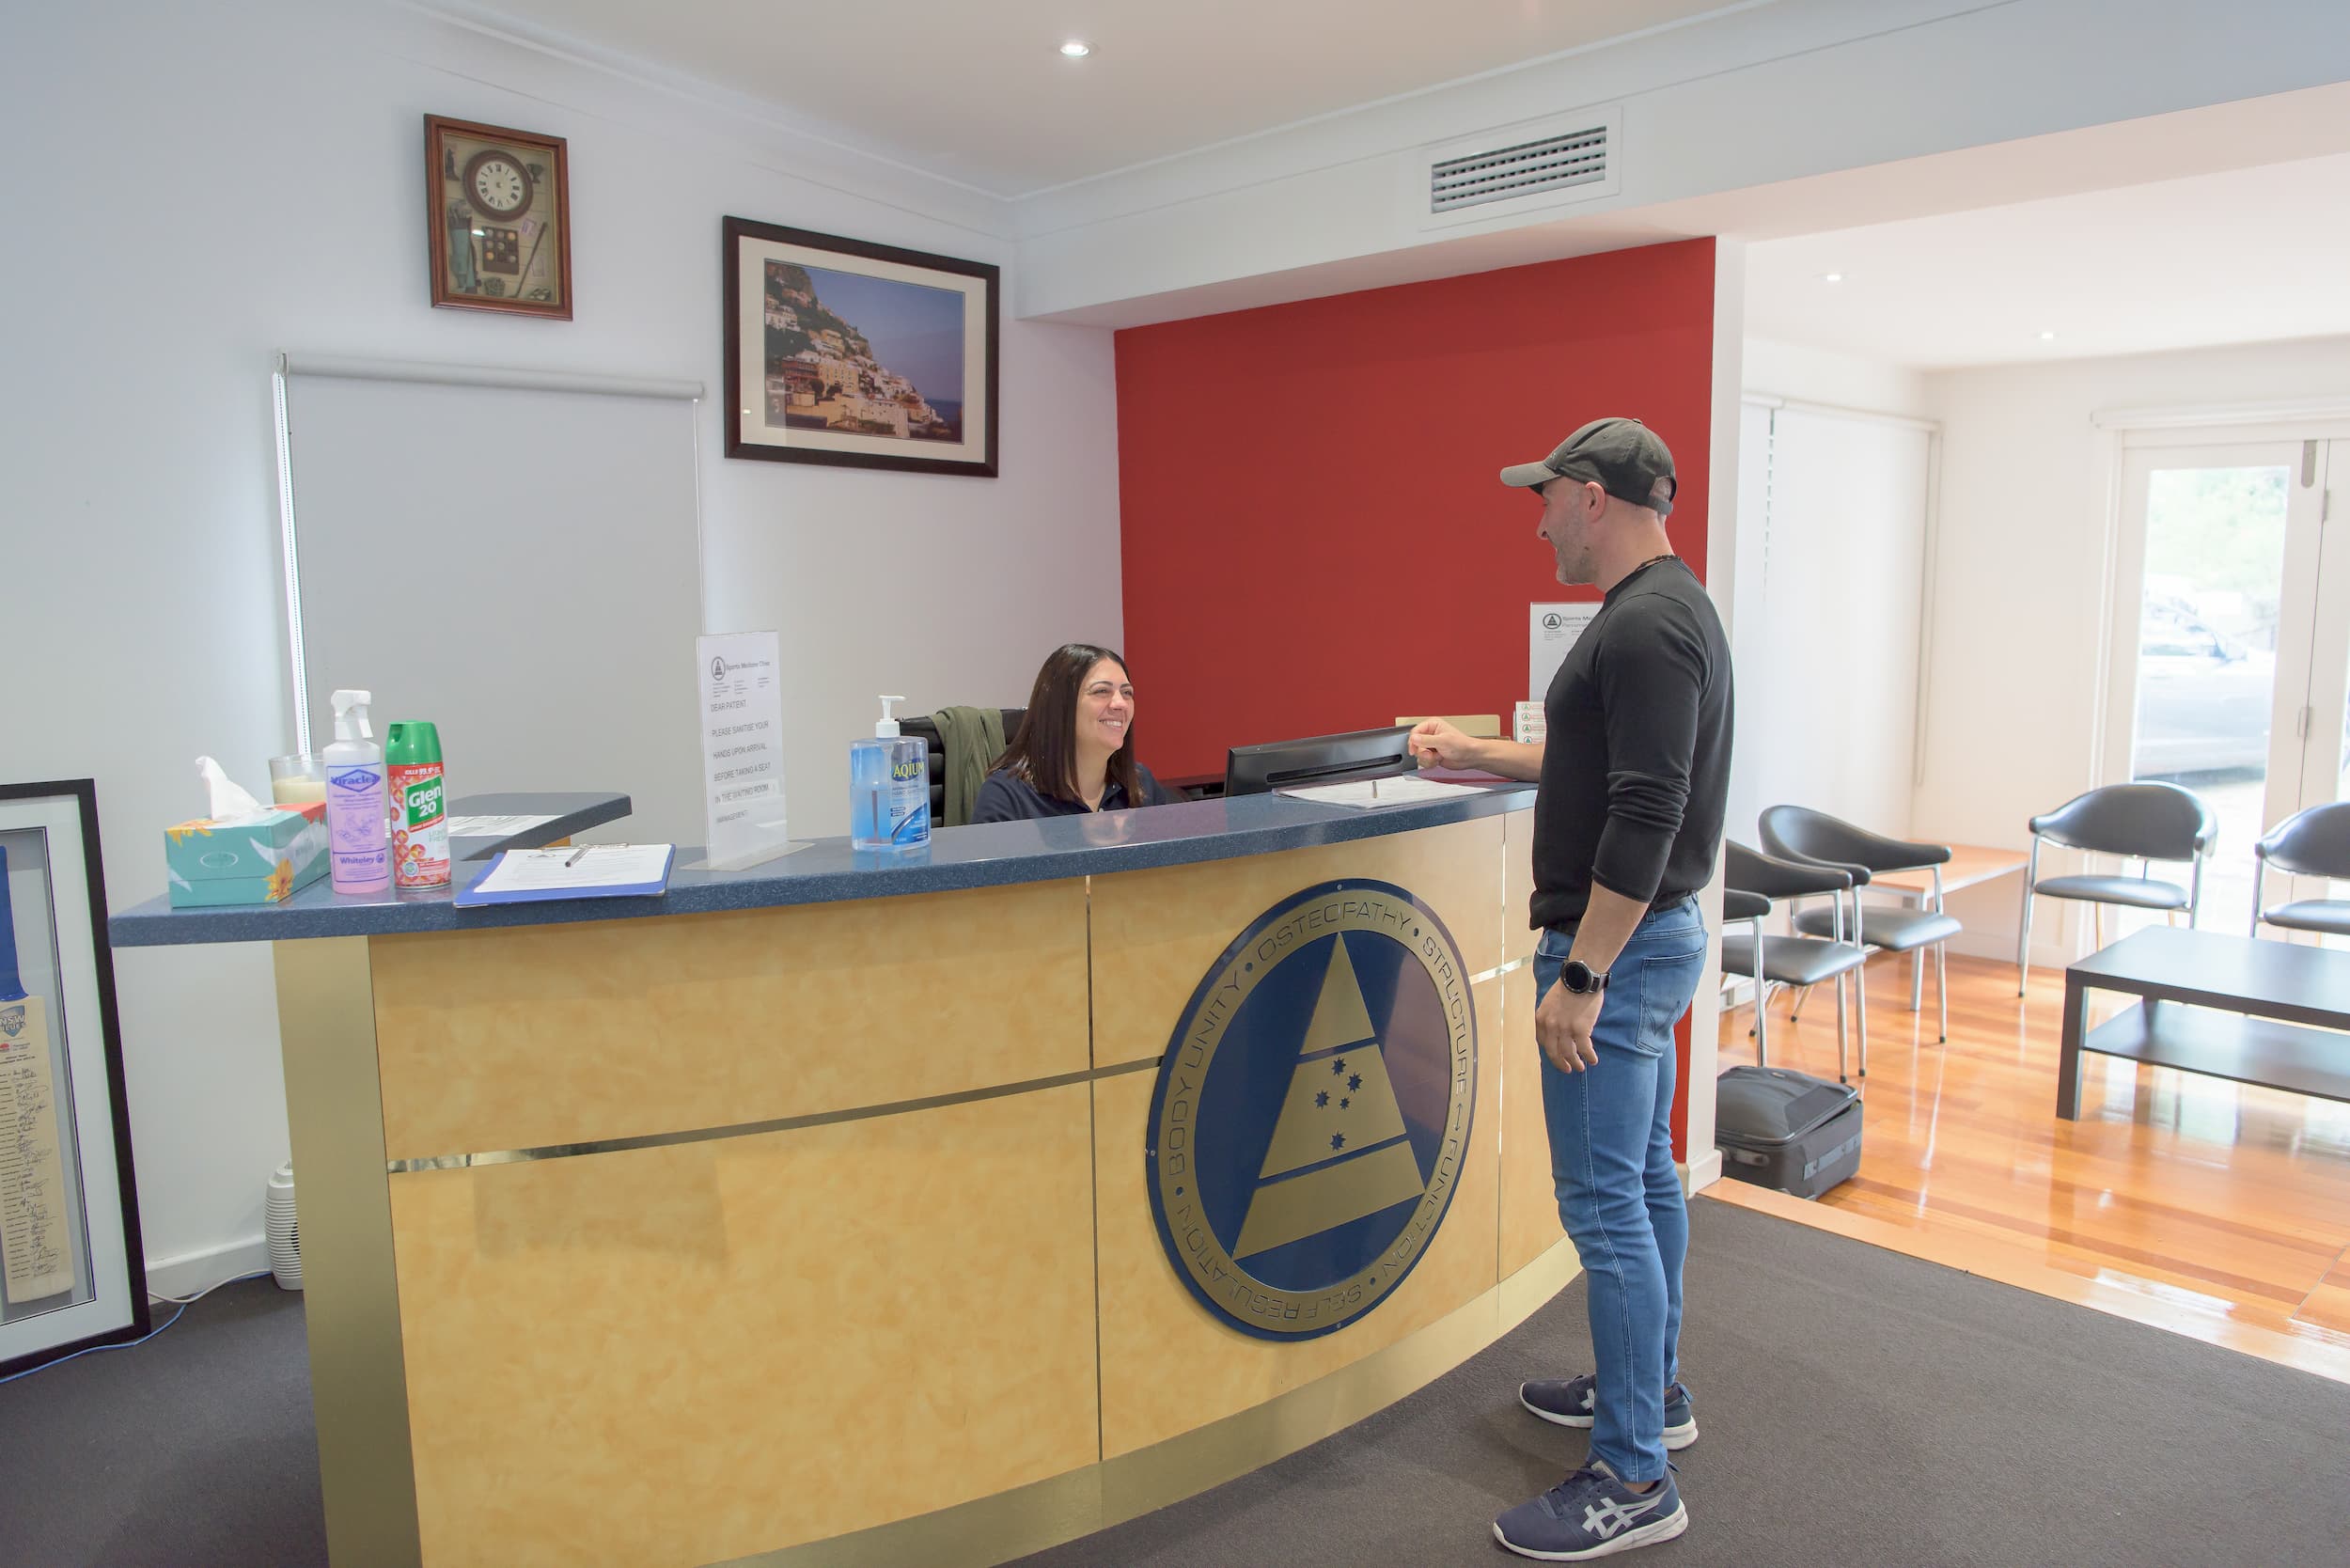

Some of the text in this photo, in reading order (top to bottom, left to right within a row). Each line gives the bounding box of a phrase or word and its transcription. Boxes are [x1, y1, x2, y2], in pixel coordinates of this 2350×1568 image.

[710, 703, 725, 713] DEAR
[712, 727, 731, 737] PLEASE
[755, 720, 769, 730] YOUR
[713, 748, 730, 760] HANDS
[732, 745, 746, 755] UPON
[714, 770, 734, 781] BEFORE
[735, 766, 753, 776] TAKING
[408, 786, 442, 808] Glen
[722, 792, 732, 802] THE
[733, 788, 753, 799] WAITING
[419, 801, 437, 817] 20
[339, 856, 374, 865] Whiteley
[1257, 901, 1412, 962] OSTEOPATHY
[1422, 935, 1467, 1094] STRUCTURE
[1167, 970, 1240, 1176] BODY UNITY
